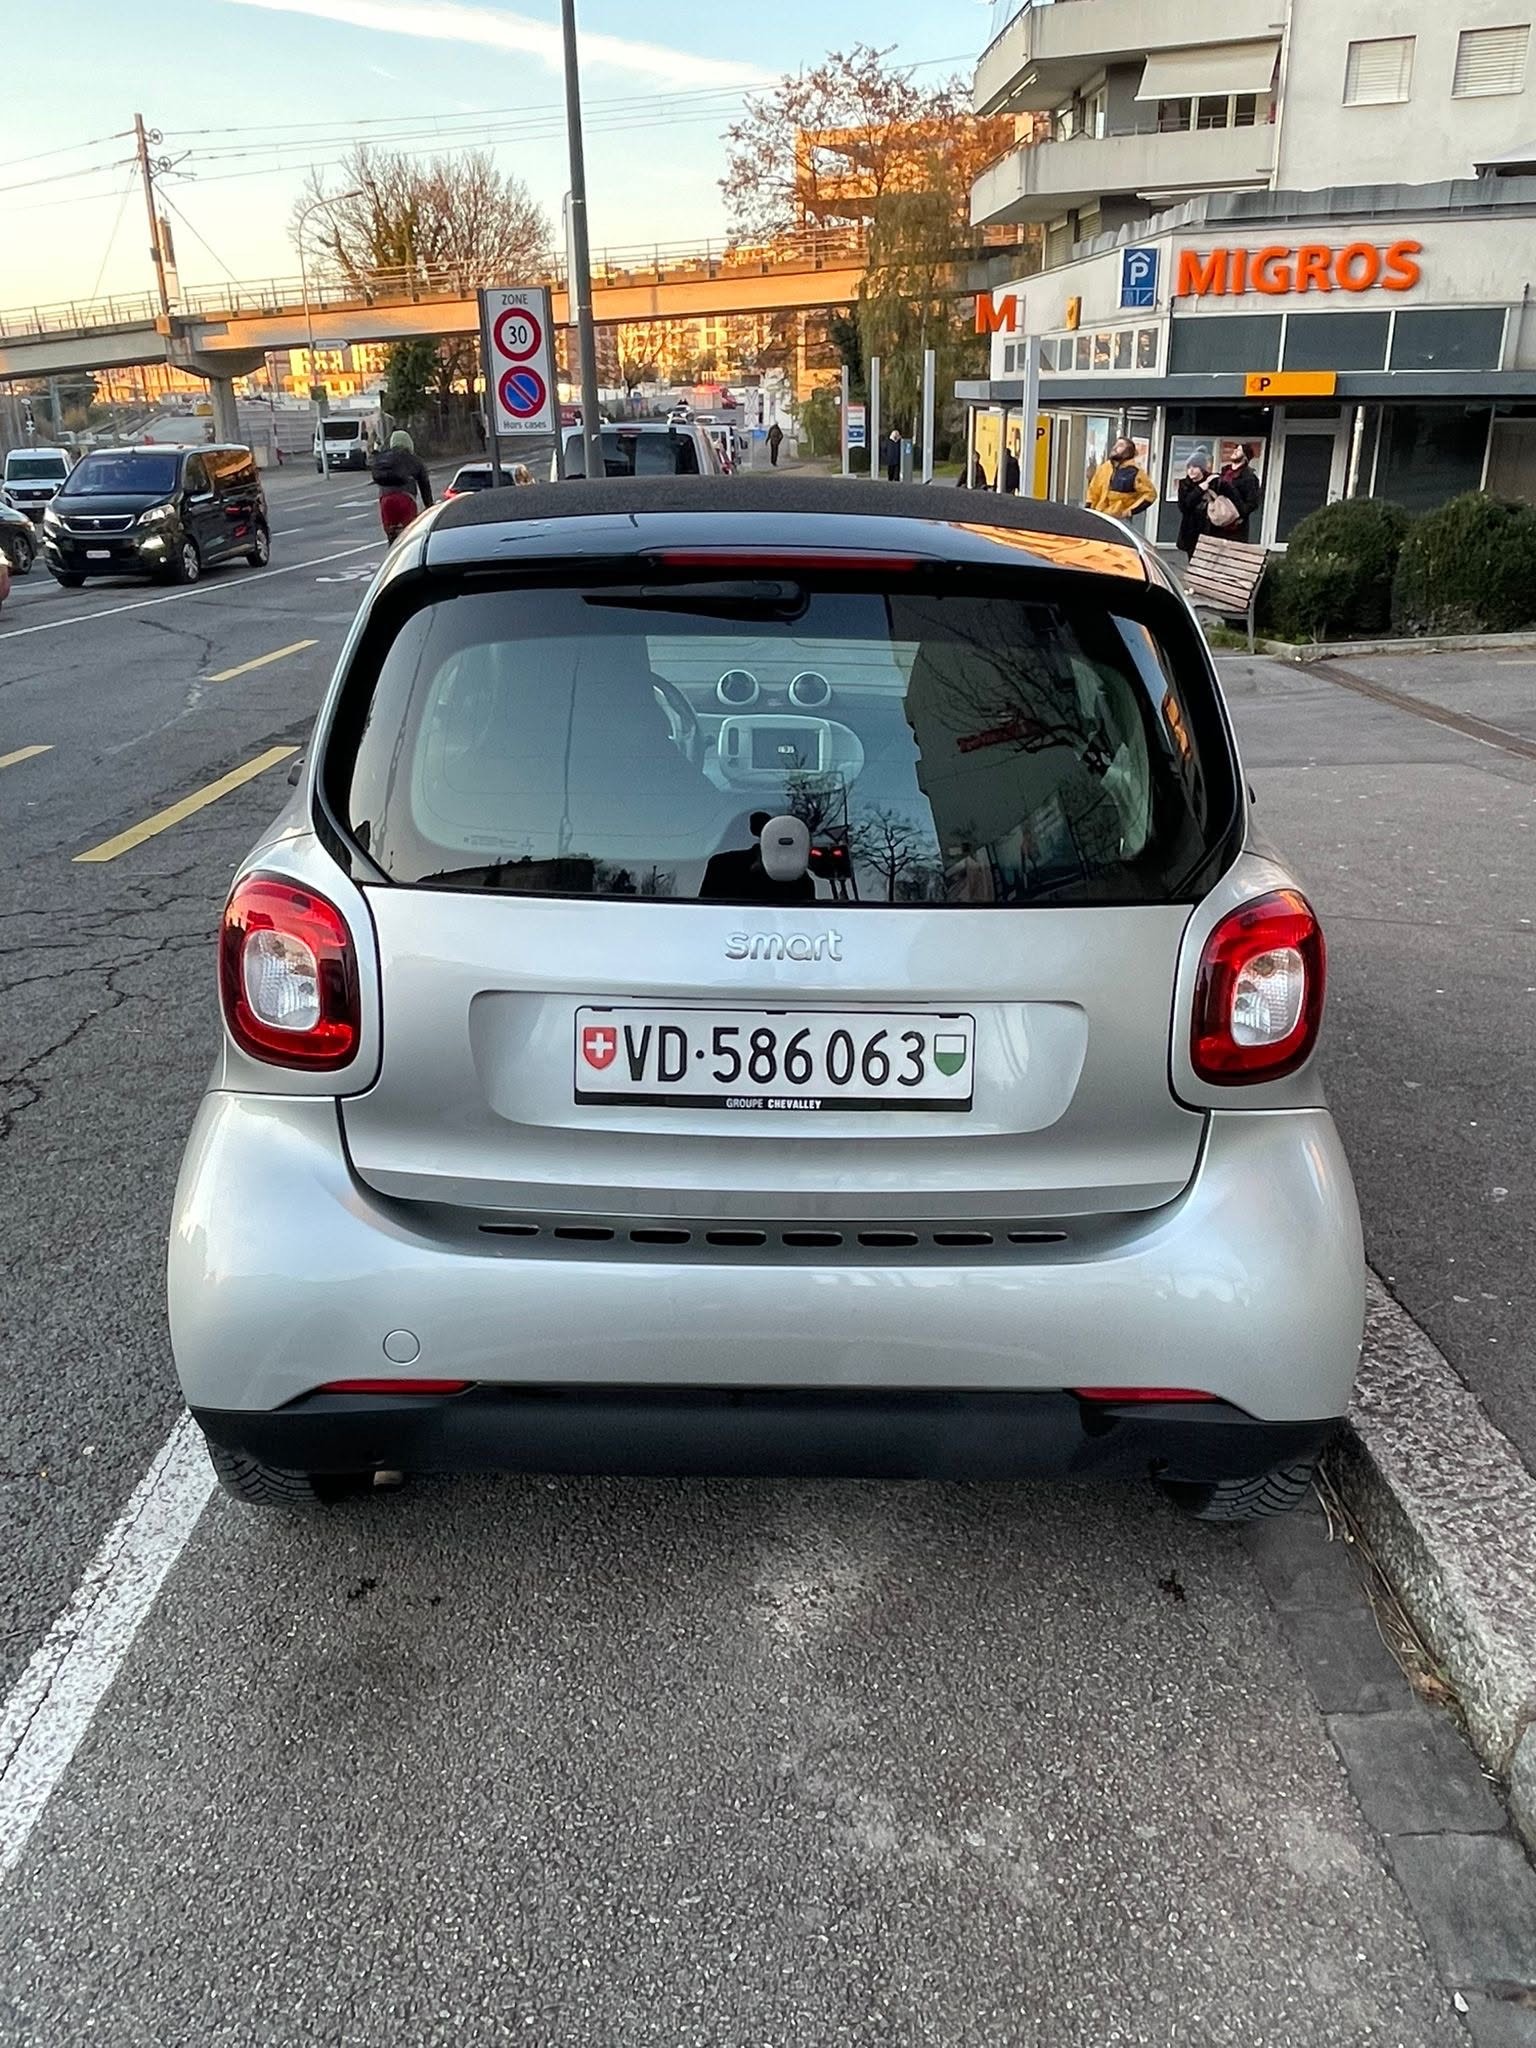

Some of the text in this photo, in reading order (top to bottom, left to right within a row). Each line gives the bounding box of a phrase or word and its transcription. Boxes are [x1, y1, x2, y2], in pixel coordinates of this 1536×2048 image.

[1129, 261, 1149, 287] P
[1176, 240, 1423, 297] MIGROS
[501, 293, 529, 306] ZONE
[975, 294, 1017, 334] M
[508, 324, 528, 345] 30
[724, 929, 844, 962] smart
[725, 1098, 822, 1110] GROUPE CHEVALLEY
